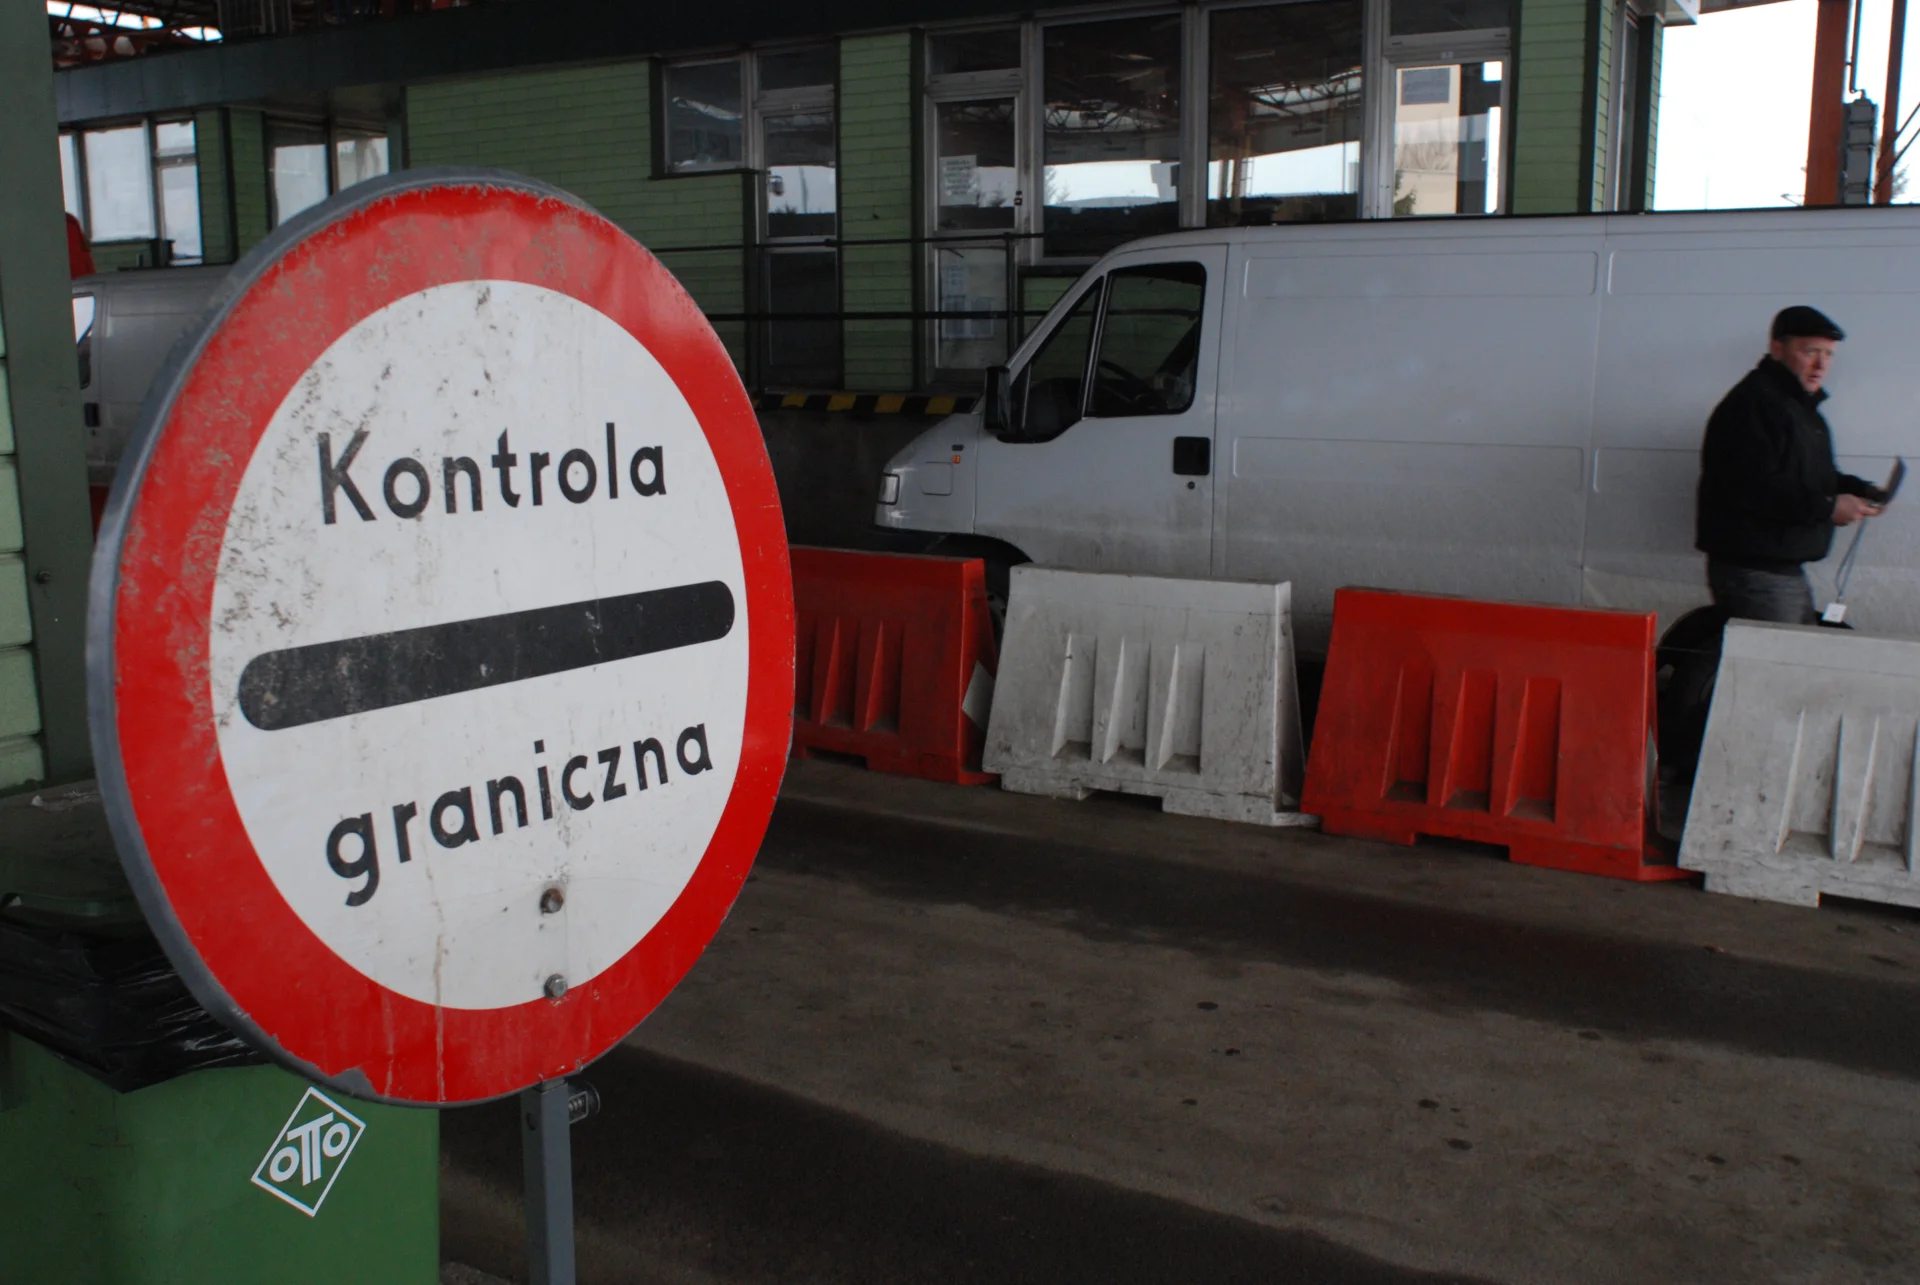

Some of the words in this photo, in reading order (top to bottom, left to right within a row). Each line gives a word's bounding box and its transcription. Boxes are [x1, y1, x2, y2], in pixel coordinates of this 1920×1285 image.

[317, 422, 667, 525] Kontrola
[326, 723, 713, 907] graniczna
[269, 1111, 351, 1187] OTTO
